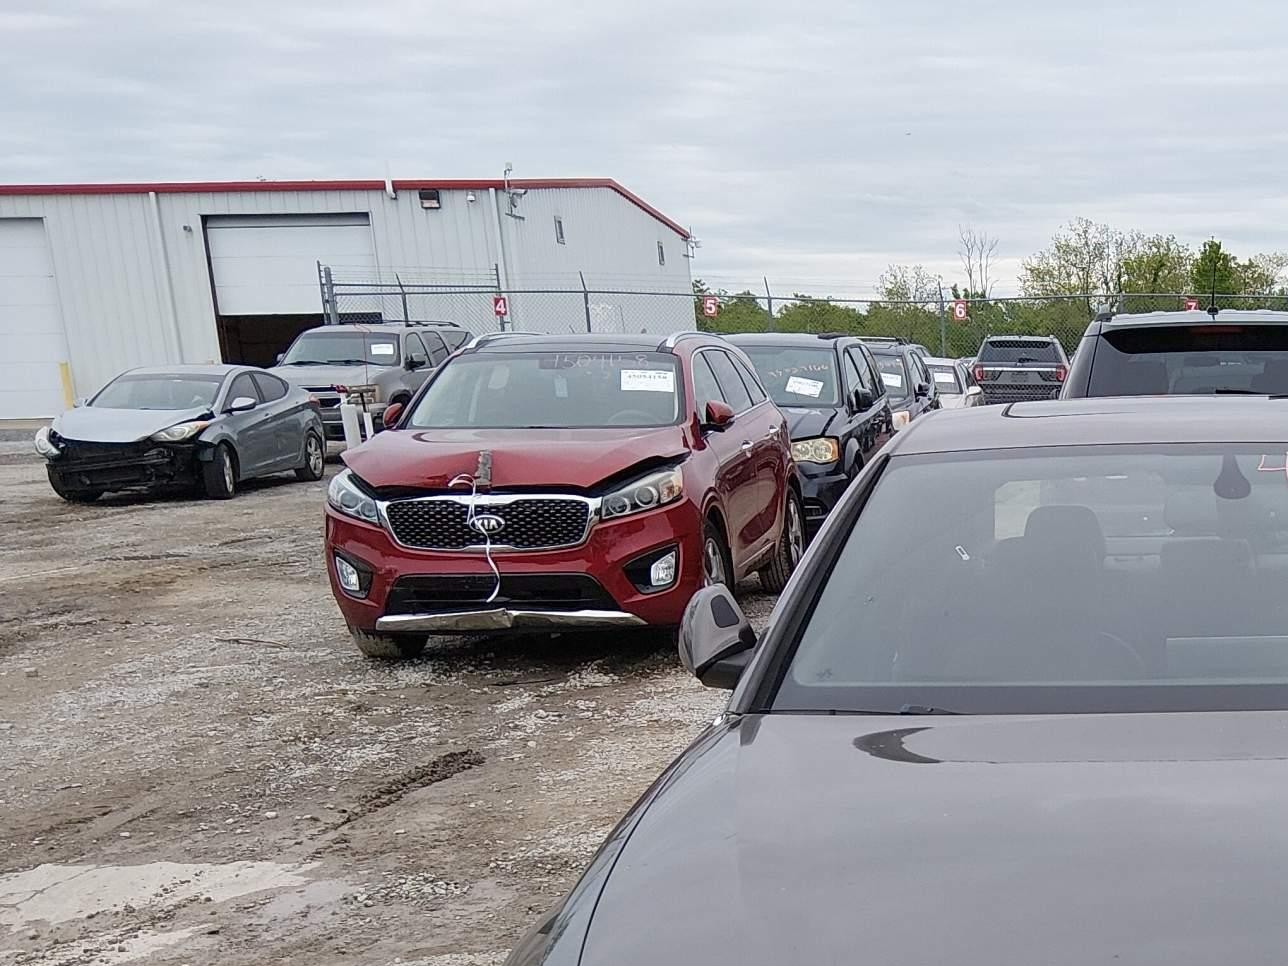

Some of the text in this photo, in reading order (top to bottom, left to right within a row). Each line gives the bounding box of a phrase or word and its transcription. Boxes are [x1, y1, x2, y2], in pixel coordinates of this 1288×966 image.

[495, 300, 506, 313] 4
[705, 299, 716, 313] 5
[955, 303, 965, 317] 6
[475, 519, 499, 530] KIA
